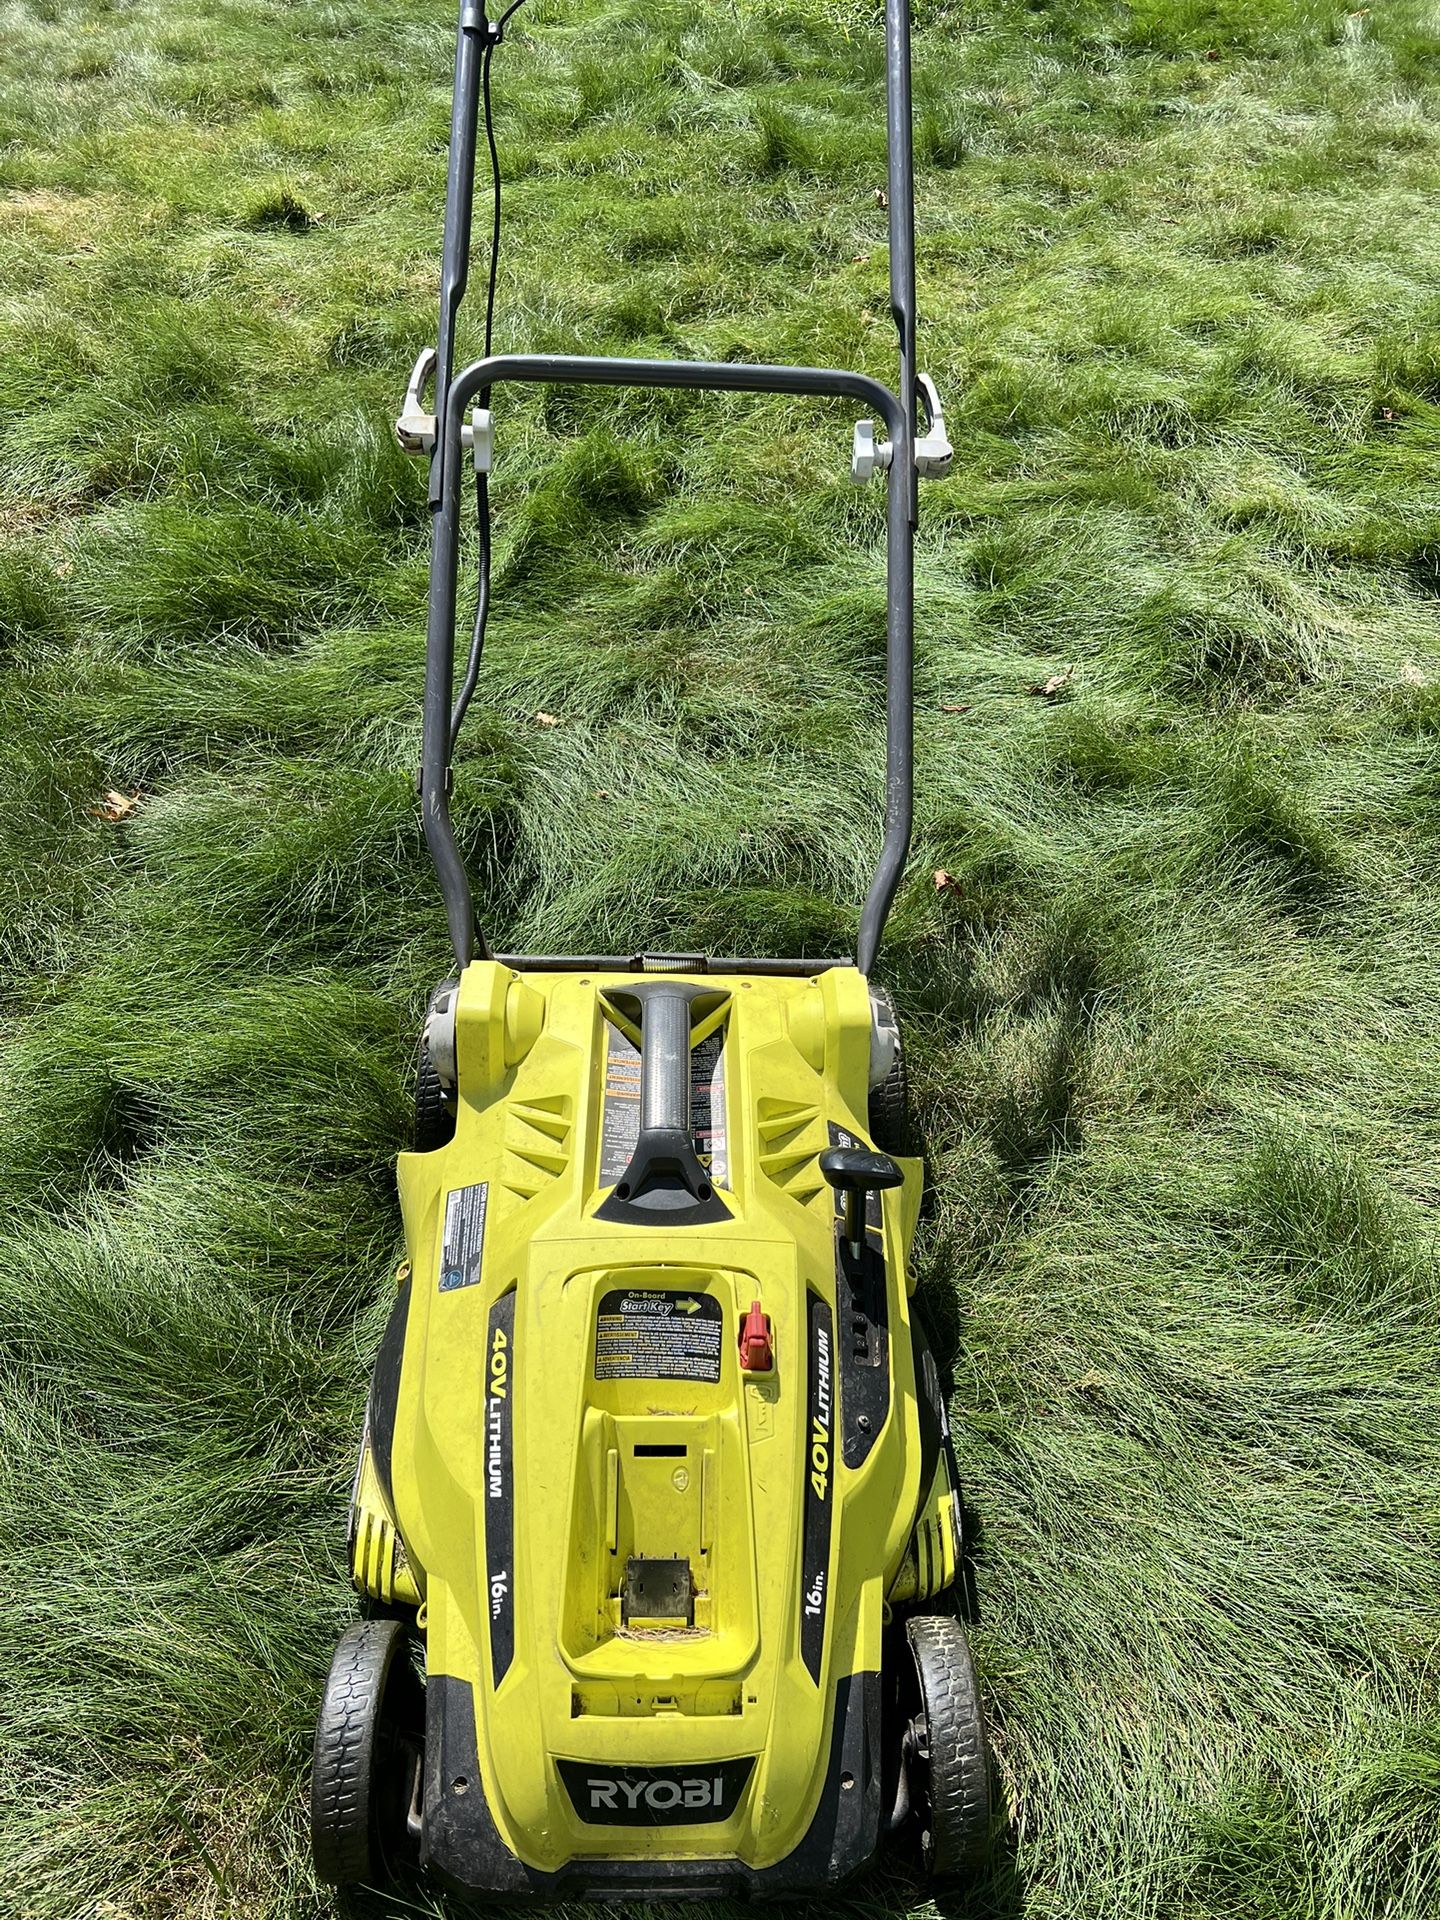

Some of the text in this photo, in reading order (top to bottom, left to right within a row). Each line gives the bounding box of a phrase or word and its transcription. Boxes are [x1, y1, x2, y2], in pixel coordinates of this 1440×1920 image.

[628, 1291, 666, 1299] On-Board
[621, 1300, 673, 1315] Start Key
[587, 1778, 724, 1809] RYOBI
